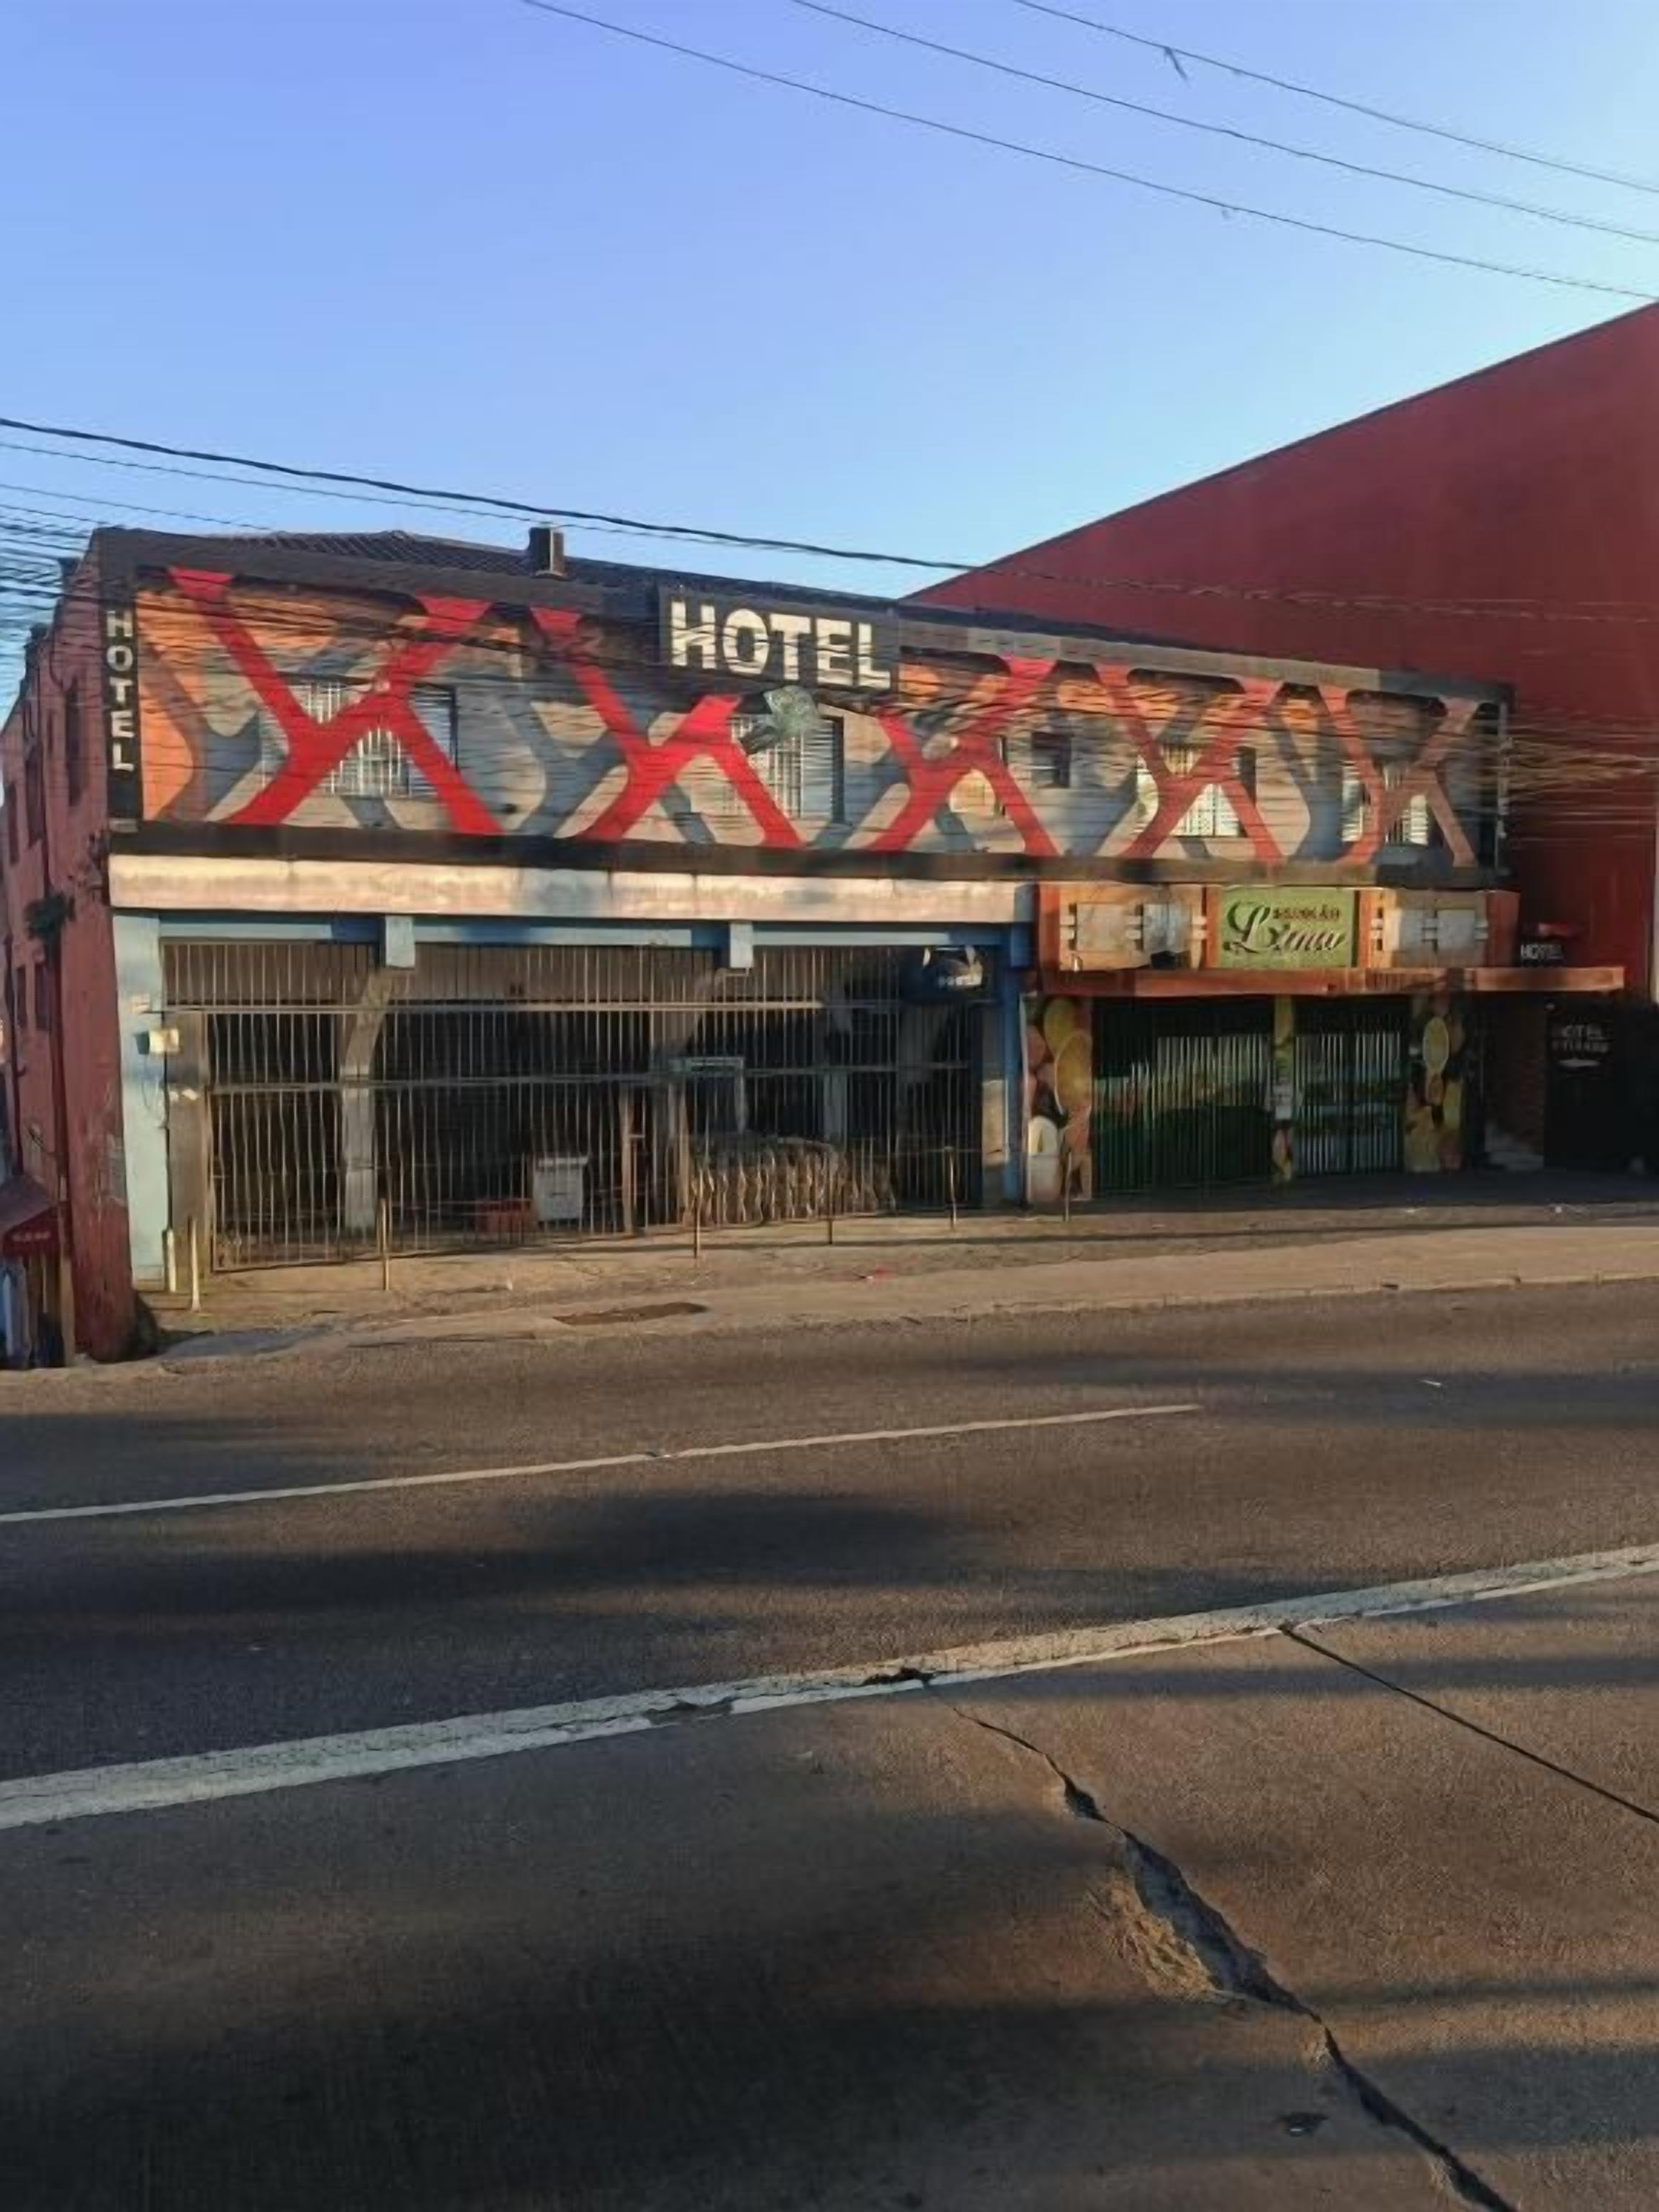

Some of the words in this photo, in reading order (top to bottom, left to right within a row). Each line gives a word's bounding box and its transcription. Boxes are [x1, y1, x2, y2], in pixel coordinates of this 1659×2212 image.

[671, 601, 891, 689] HOTEL
[107, 610, 135, 771] HOTEL
[1520, 944, 1563, 960] HOTEL
